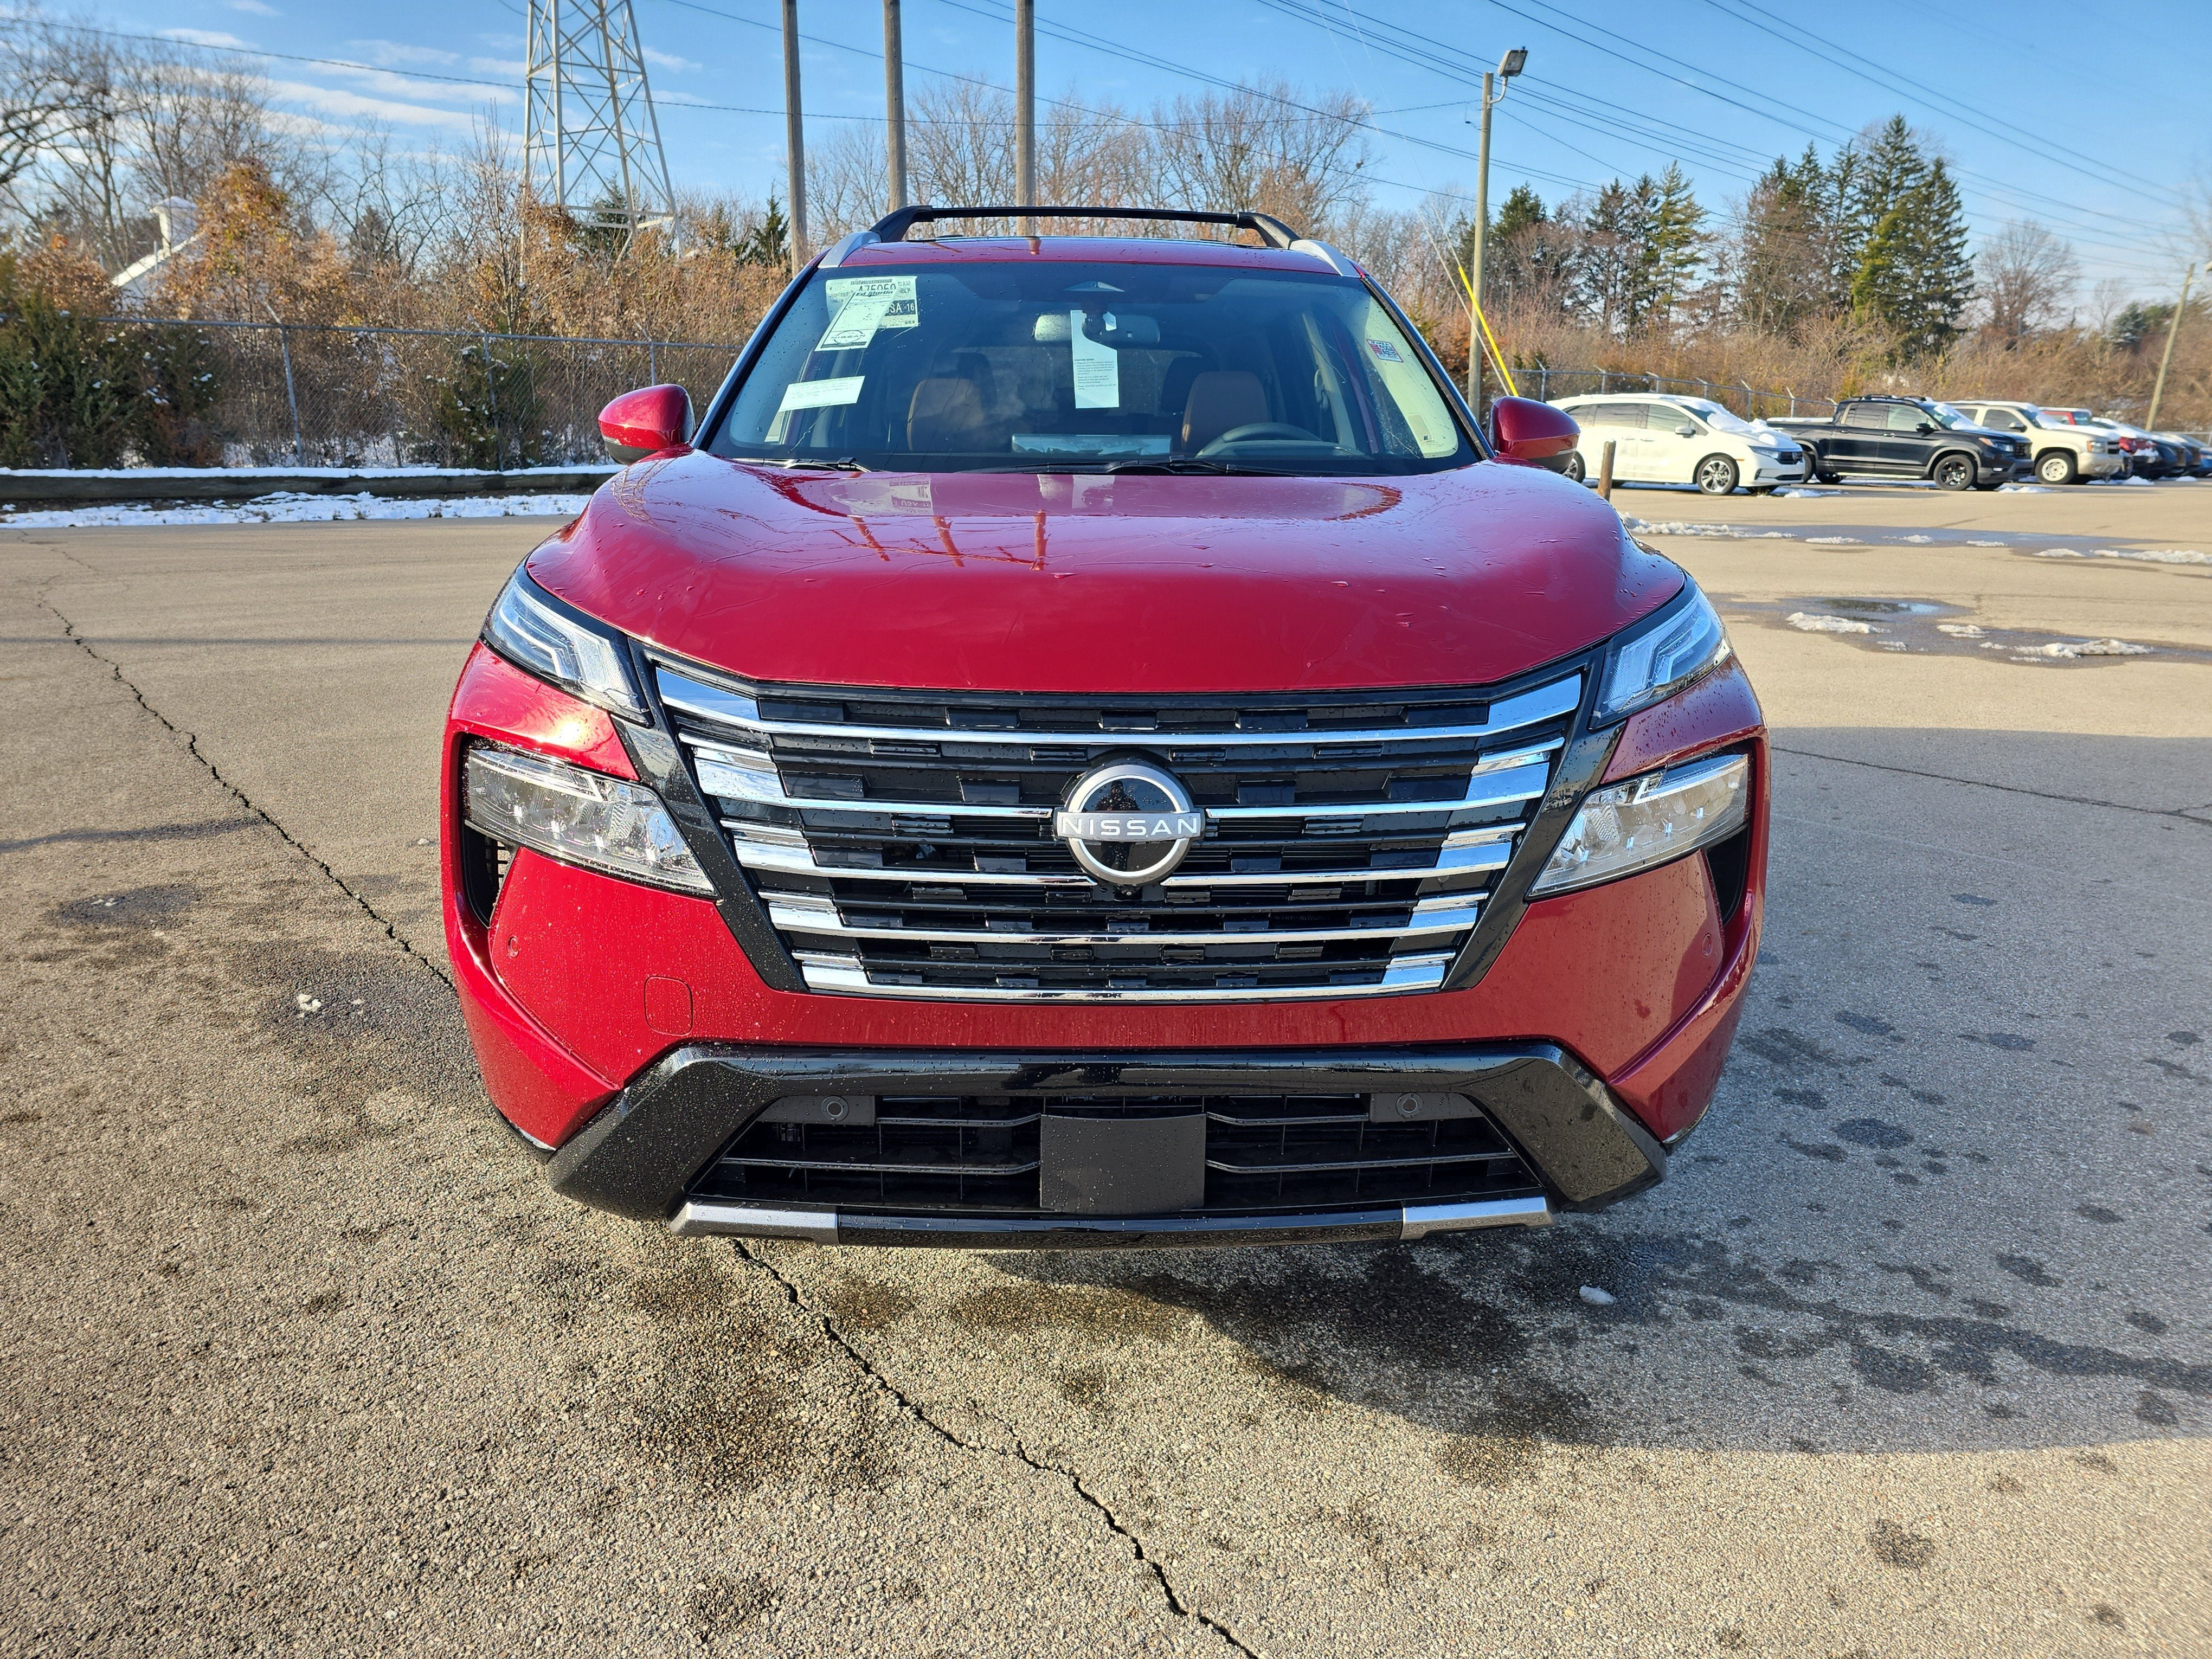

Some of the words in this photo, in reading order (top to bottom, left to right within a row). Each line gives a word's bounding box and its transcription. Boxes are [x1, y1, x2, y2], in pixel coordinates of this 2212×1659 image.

[886, 301, 902, 313] SA
[906, 303, 915, 311] 16
[1061, 817, 1198, 836] NISSAN
